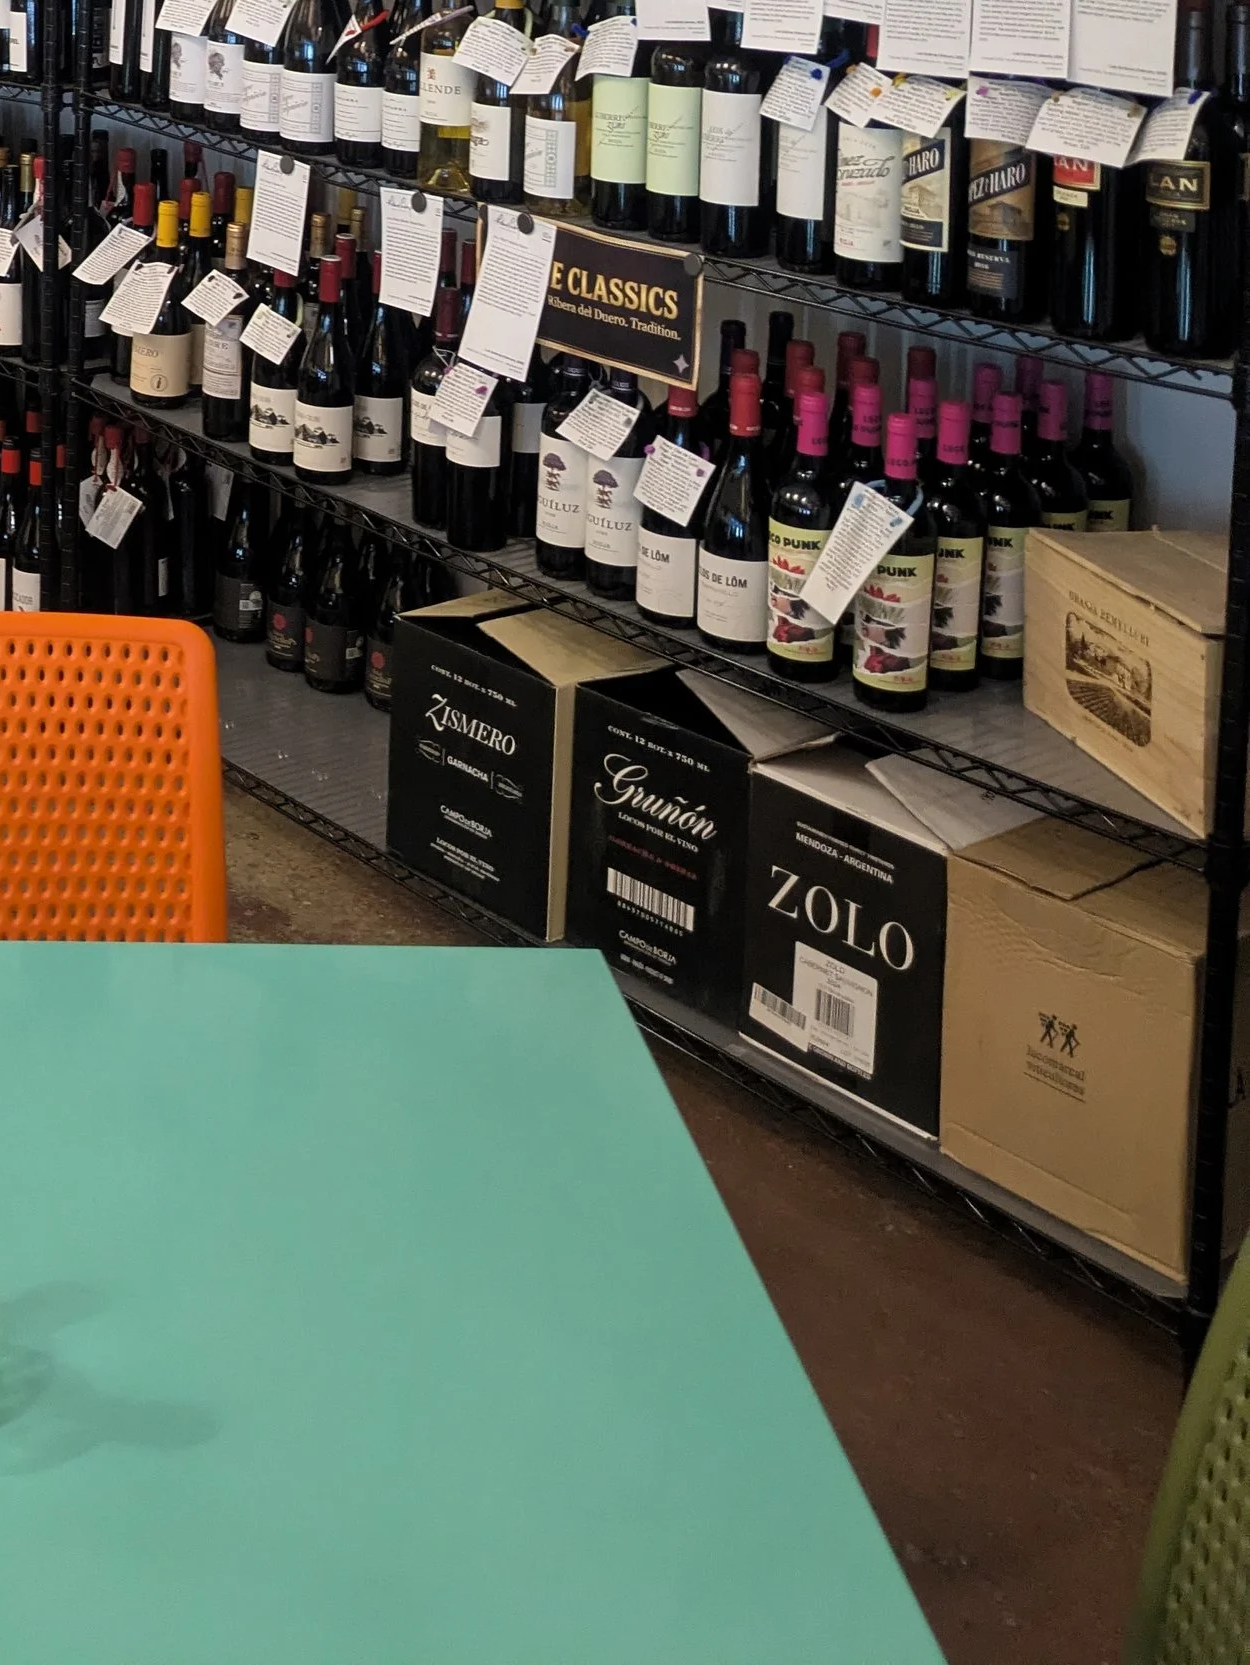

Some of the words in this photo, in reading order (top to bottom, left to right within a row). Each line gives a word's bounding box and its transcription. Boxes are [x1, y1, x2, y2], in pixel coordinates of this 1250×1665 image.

[909, 148, 939, 175] HARO
[990, 163, 1025, 193] HARO
[567, 267, 678, 319] CLASSICS
[548, 295, 576, 313] Ribera
[578, 303, 592, 318] del
[594, 309, 628, 328] Duero.
[630, 317, 681, 341] Tradition.
[641, 546, 649, 555] DE
[651, 550, 670, 563] LÔM
[783, 538, 821, 551] PUNK
[712, 572, 723, 584] DE
[725, 575, 748, 588] LÔM
[876, 566, 917, 578] PUNK
[453, 674, 462, 682] 12
[488, 689, 504, 701] 750
[425, 693, 516, 755] ZISMERO
[608, 725, 632, 740] CONT.
[635, 735, 645, 745] 12
[676, 752, 694, 765] 750
[696, 762, 710, 772] ML
[447, 755, 489, 782] GARNACHA
[594, 753, 717, 839] Gruñón
[440, 805, 464, 822] CAMPO
[618, 812, 645, 829] LOCOS
[646, 823, 664, 837] POR
[665, 832, 675, 843] EL
[676, 837, 699, 853] VINO
[795, 832, 838, 858] MENDOZA
[843, 854, 894, 884] ARGENTINA
[768, 865, 914, 971] ZOLO
[619, 930, 646, 949] CAMPO
[653, 945, 677, 965] BORJA
